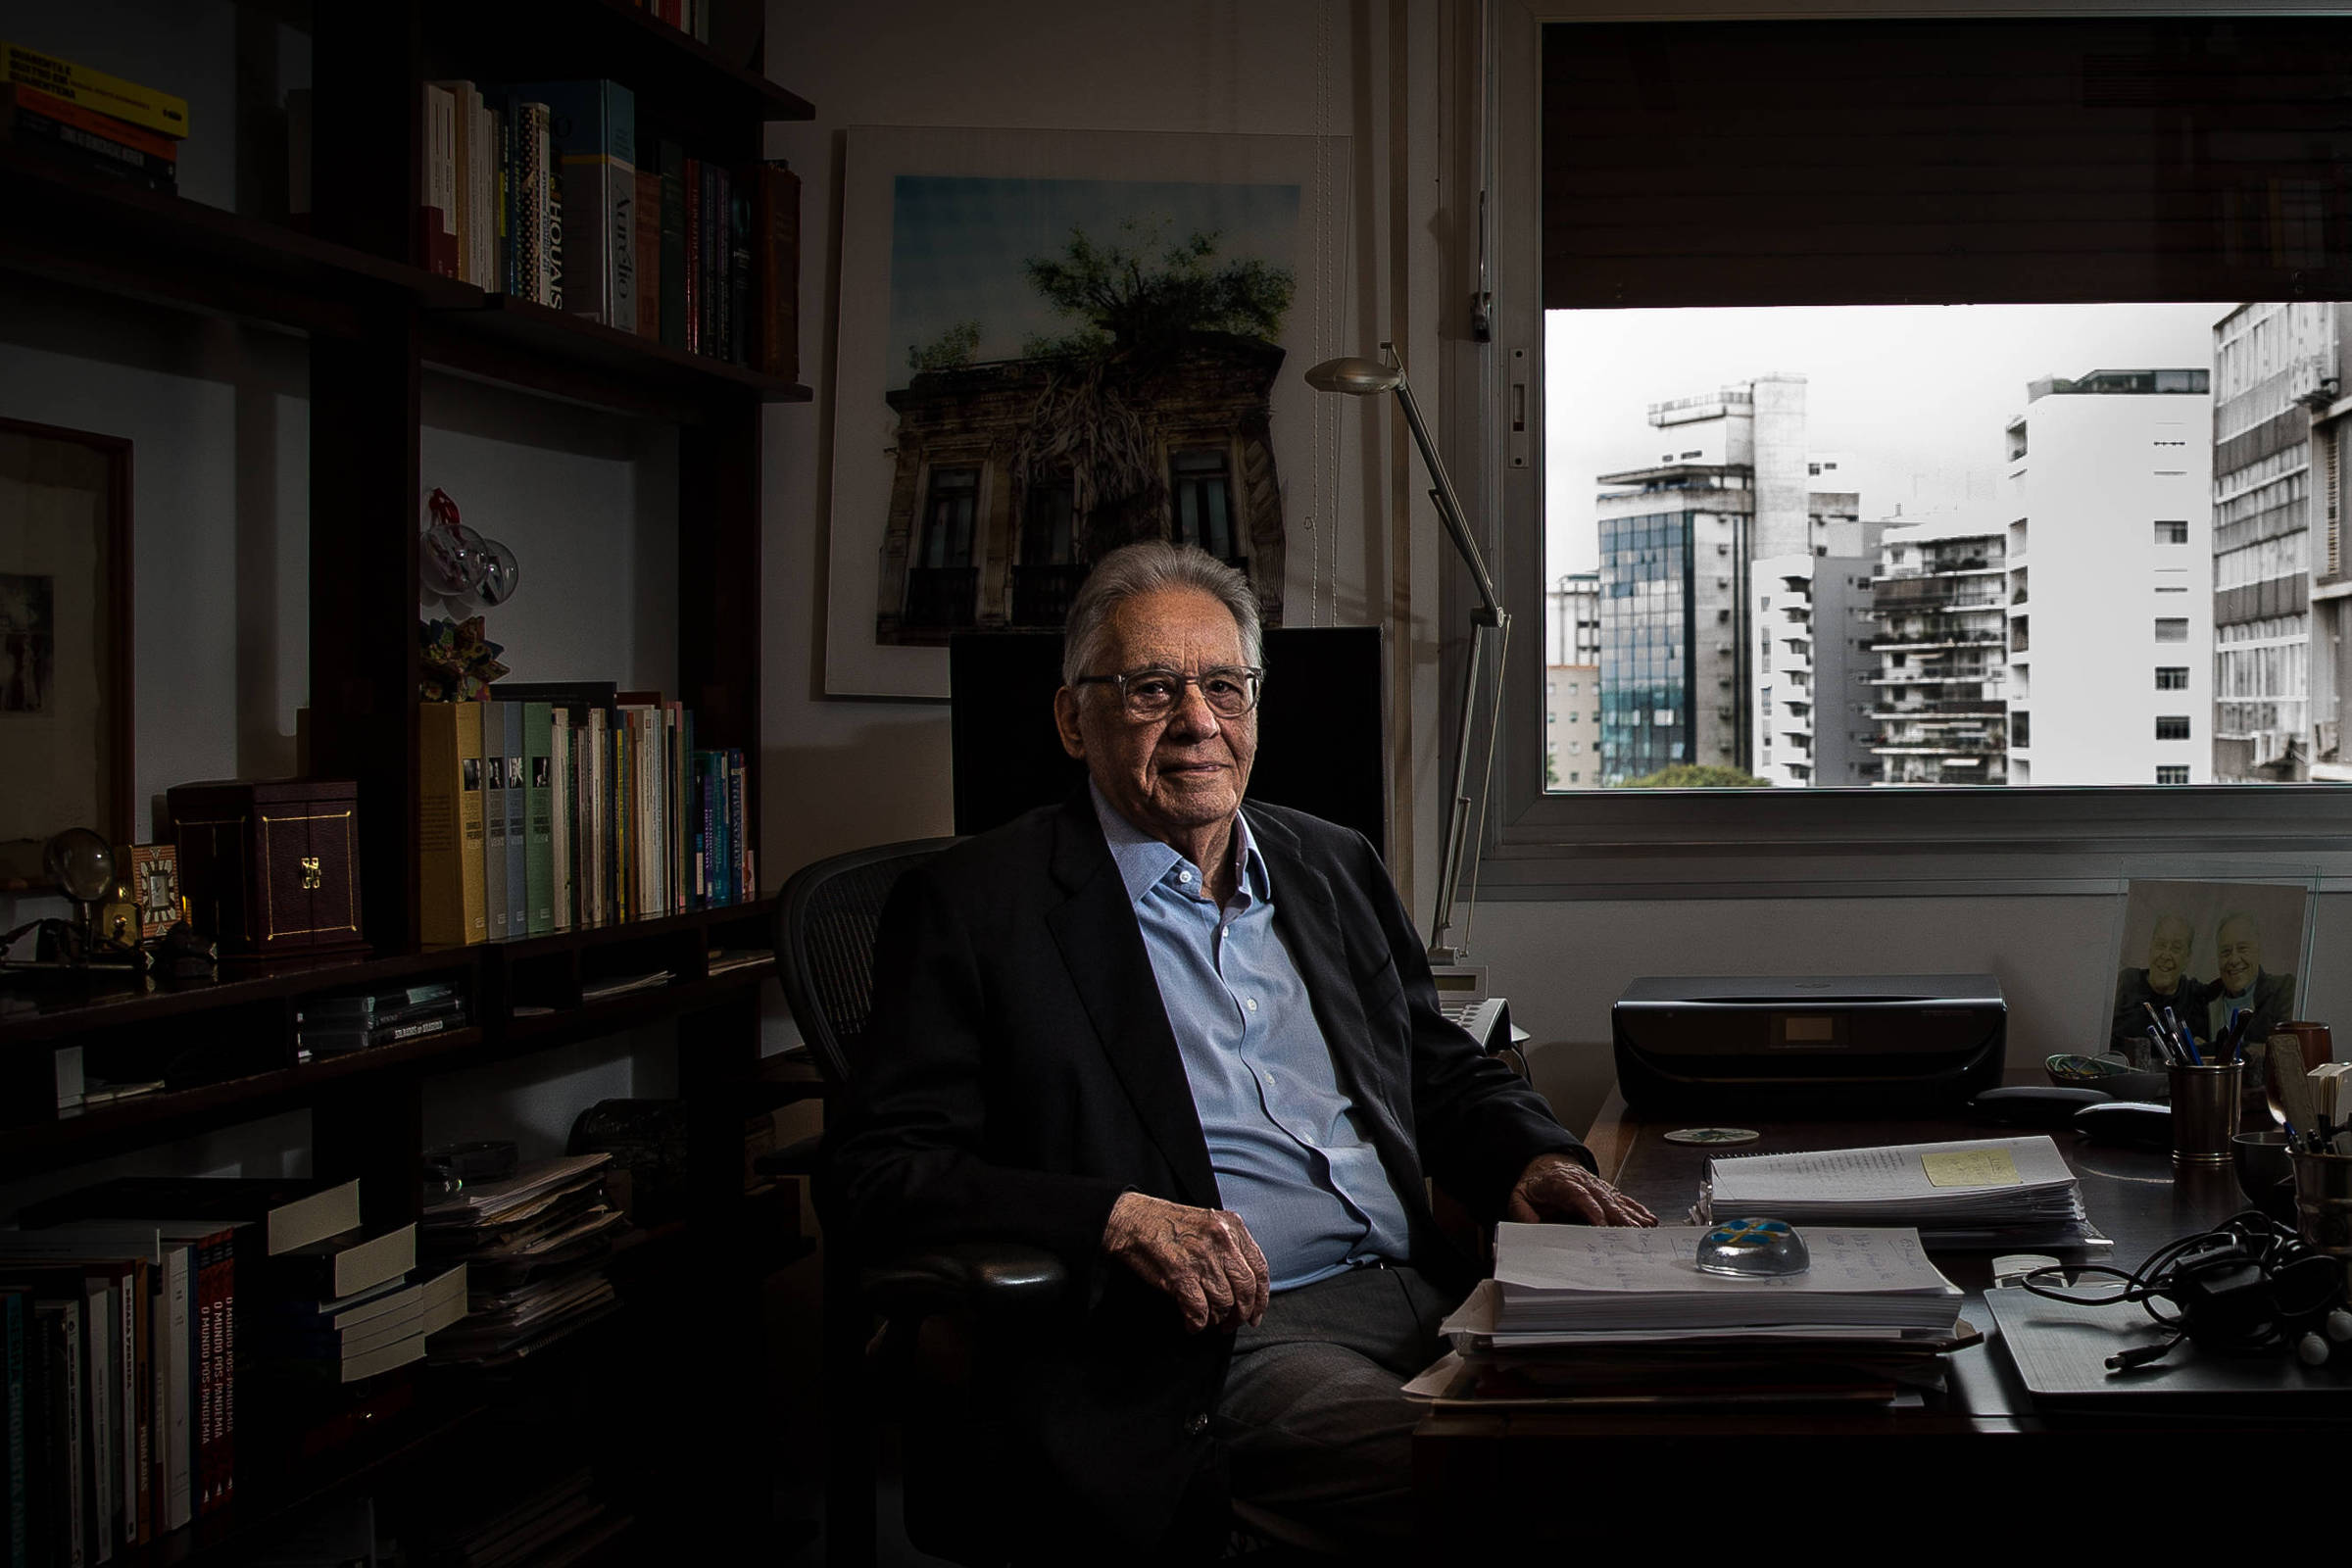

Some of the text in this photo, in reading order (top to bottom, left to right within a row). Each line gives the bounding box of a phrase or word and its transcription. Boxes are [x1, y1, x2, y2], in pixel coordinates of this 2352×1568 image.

[549, 199, 564, 311] HOUAIS
[615, 184, 633, 299] Aurélio
[201, 1317, 210, 1358] MUNDO
[213, 1312, 223, 1353] MUNDO
[225, 1307, 234, 1348] MUNDO
